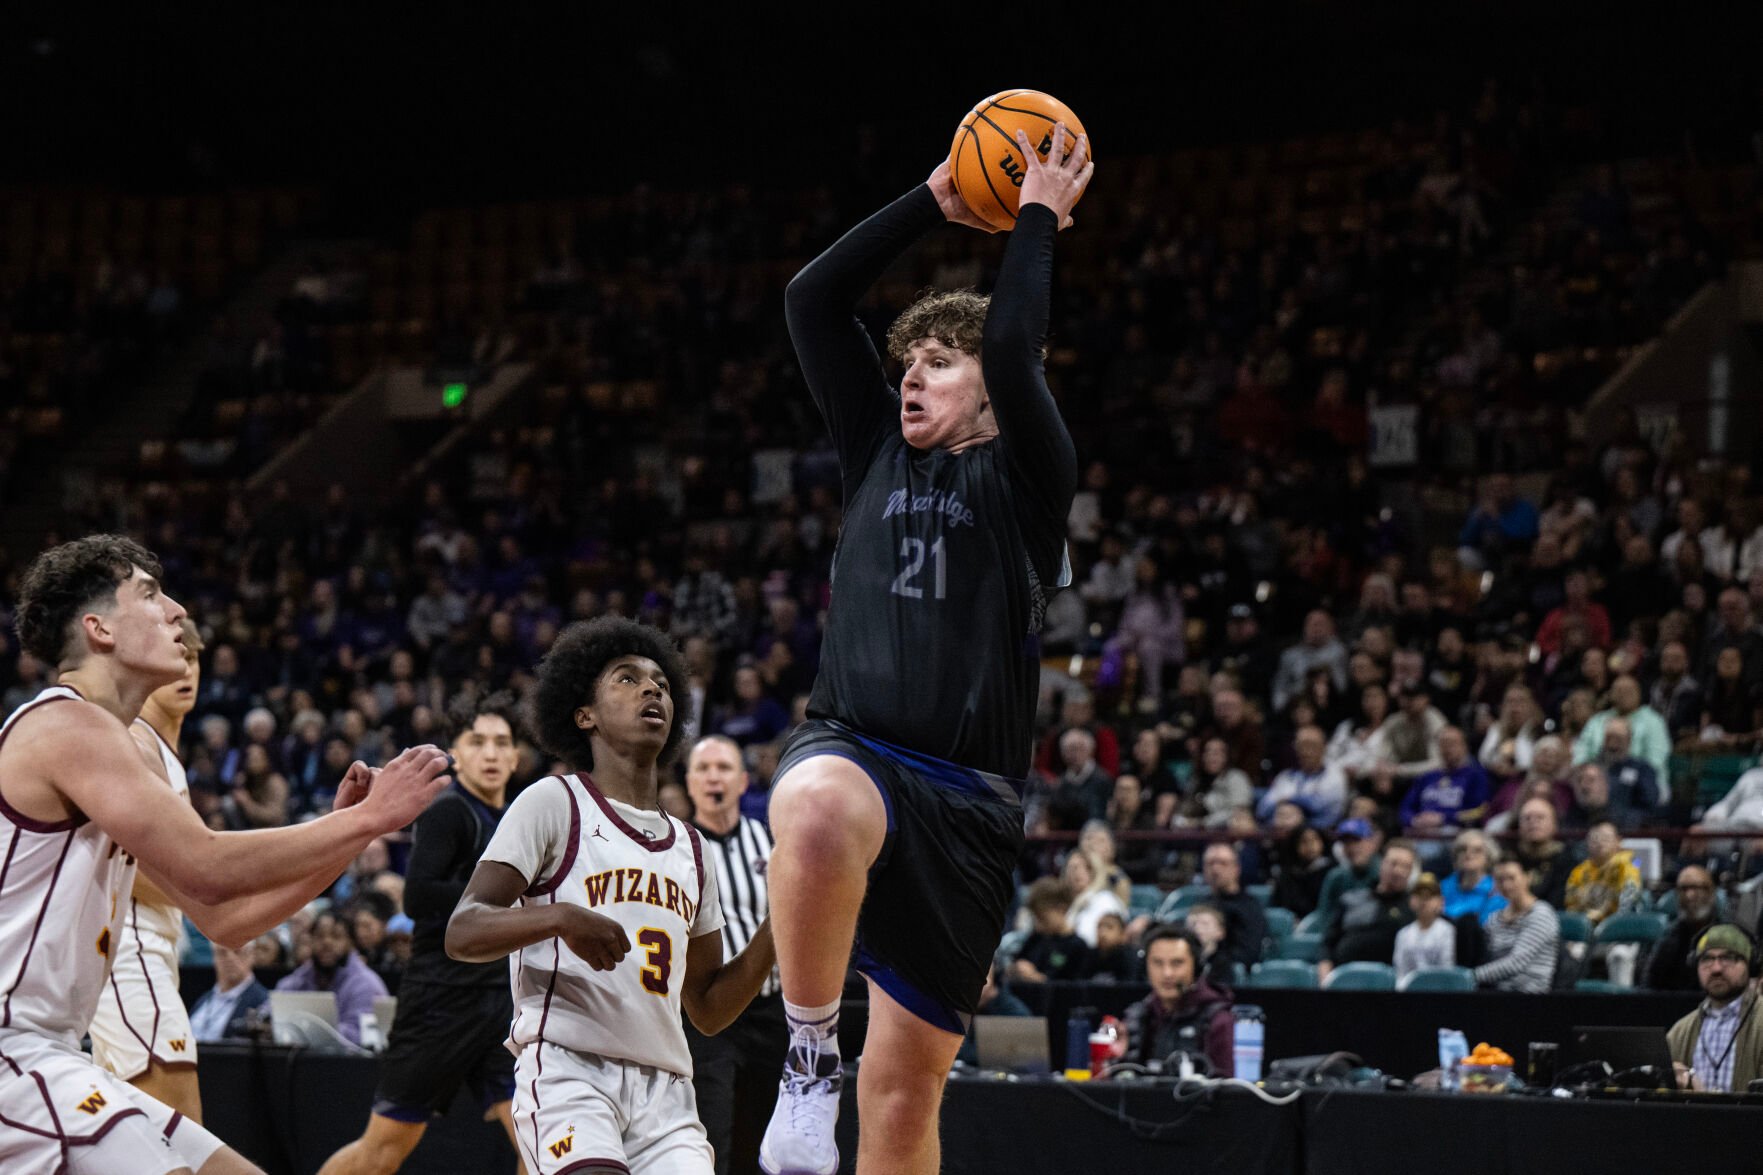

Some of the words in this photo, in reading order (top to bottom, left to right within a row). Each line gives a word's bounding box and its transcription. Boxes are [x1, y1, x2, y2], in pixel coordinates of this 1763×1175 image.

[891, 536, 947, 599] 21
[584, 868, 698, 928] WIZARD
[636, 925, 672, 998] 3
[78, 1090, 107, 1115] W
[548, 1135, 573, 1159] W
